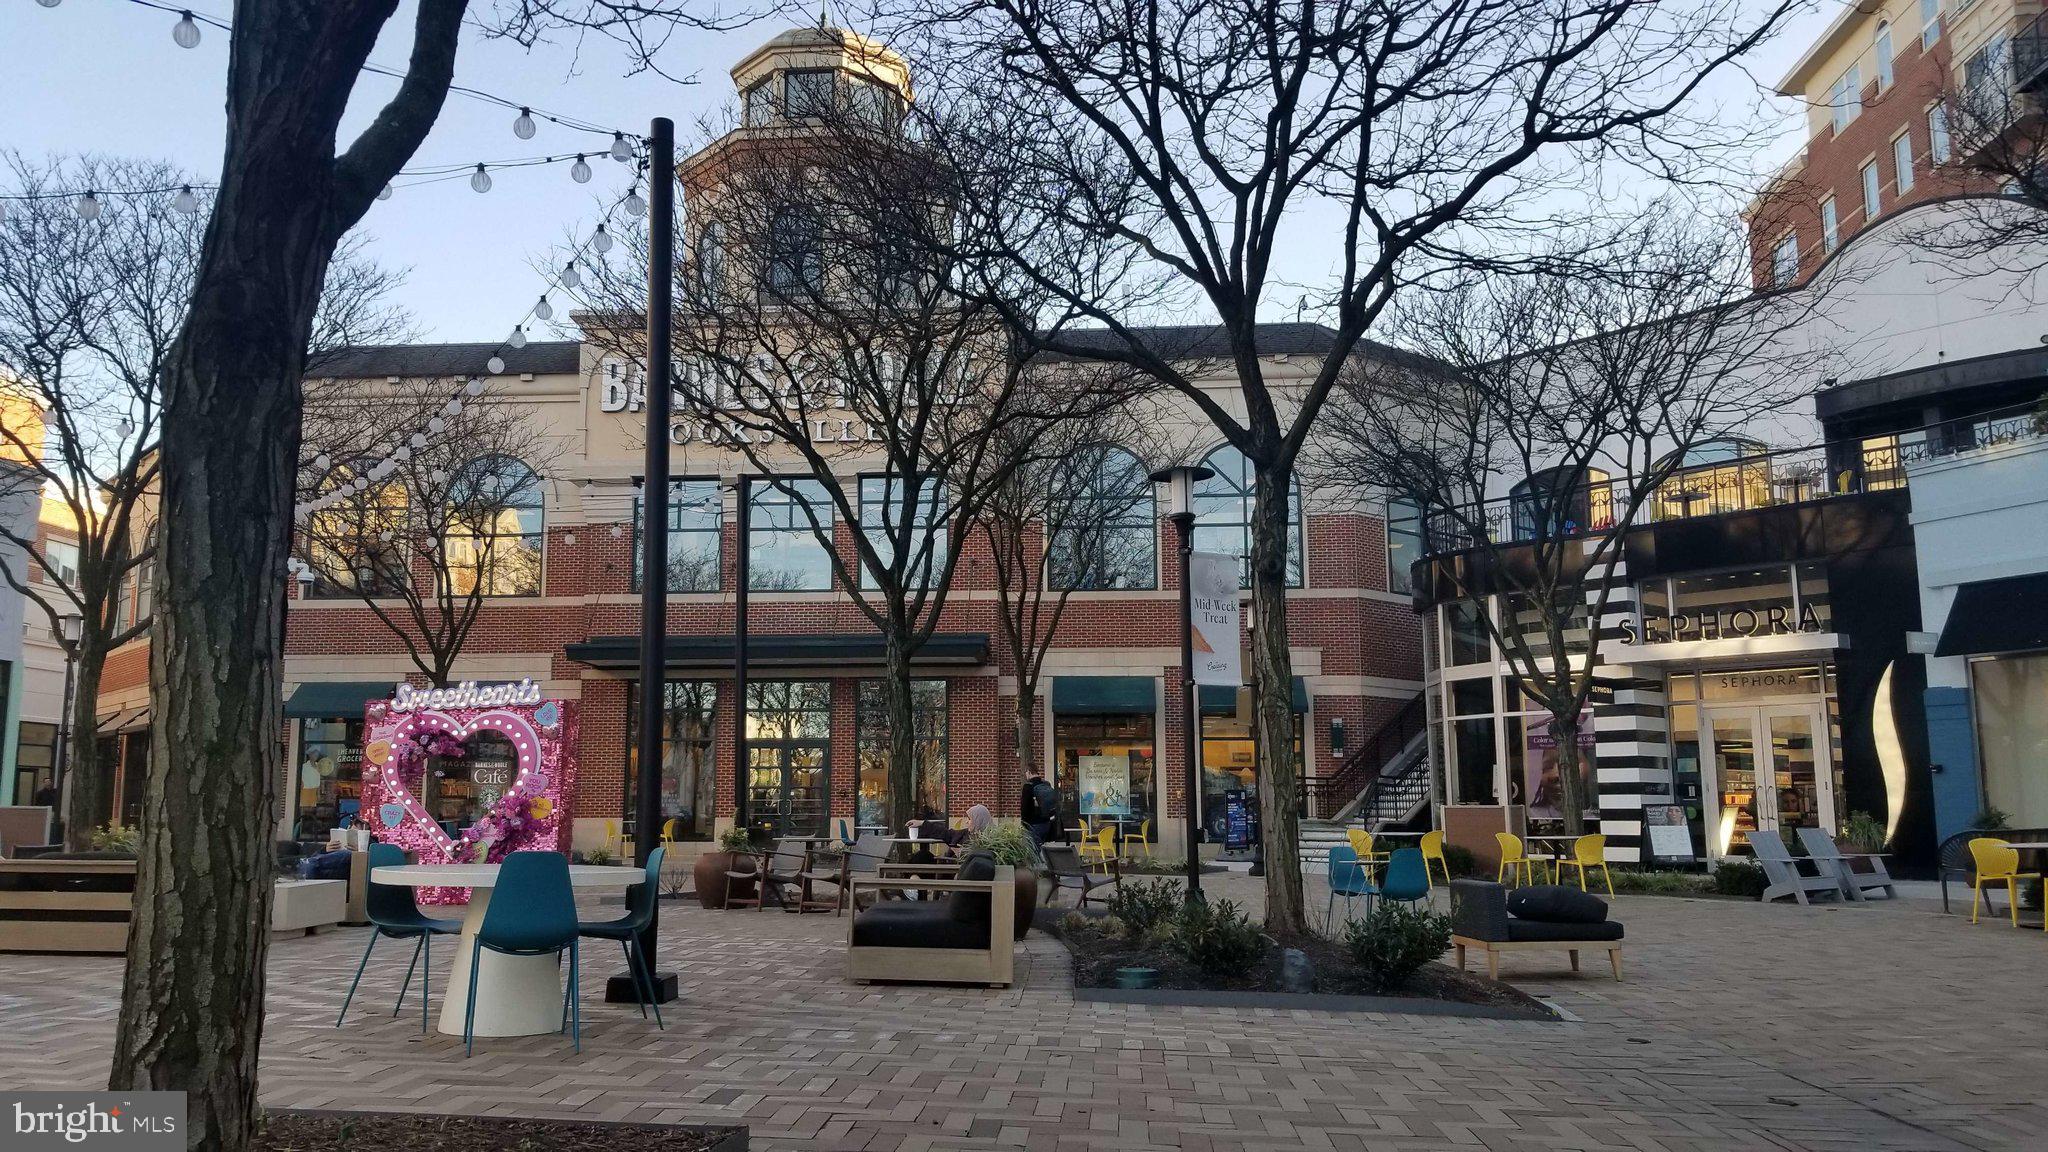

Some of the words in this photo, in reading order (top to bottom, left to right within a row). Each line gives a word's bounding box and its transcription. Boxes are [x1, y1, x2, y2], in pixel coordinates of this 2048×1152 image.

[1194, 598, 1237, 612] Mid-Week
[1202, 612, 1229, 624] Treat
[1618, 602, 1824, 646] SEPHORA
[1721, 674, 1798, 689] SEPHORA
[390, 677, 542, 713] Sweethearts
[1591, 685, 1613, 694] SEPHORA
[474, 768, 508, 784] Café
